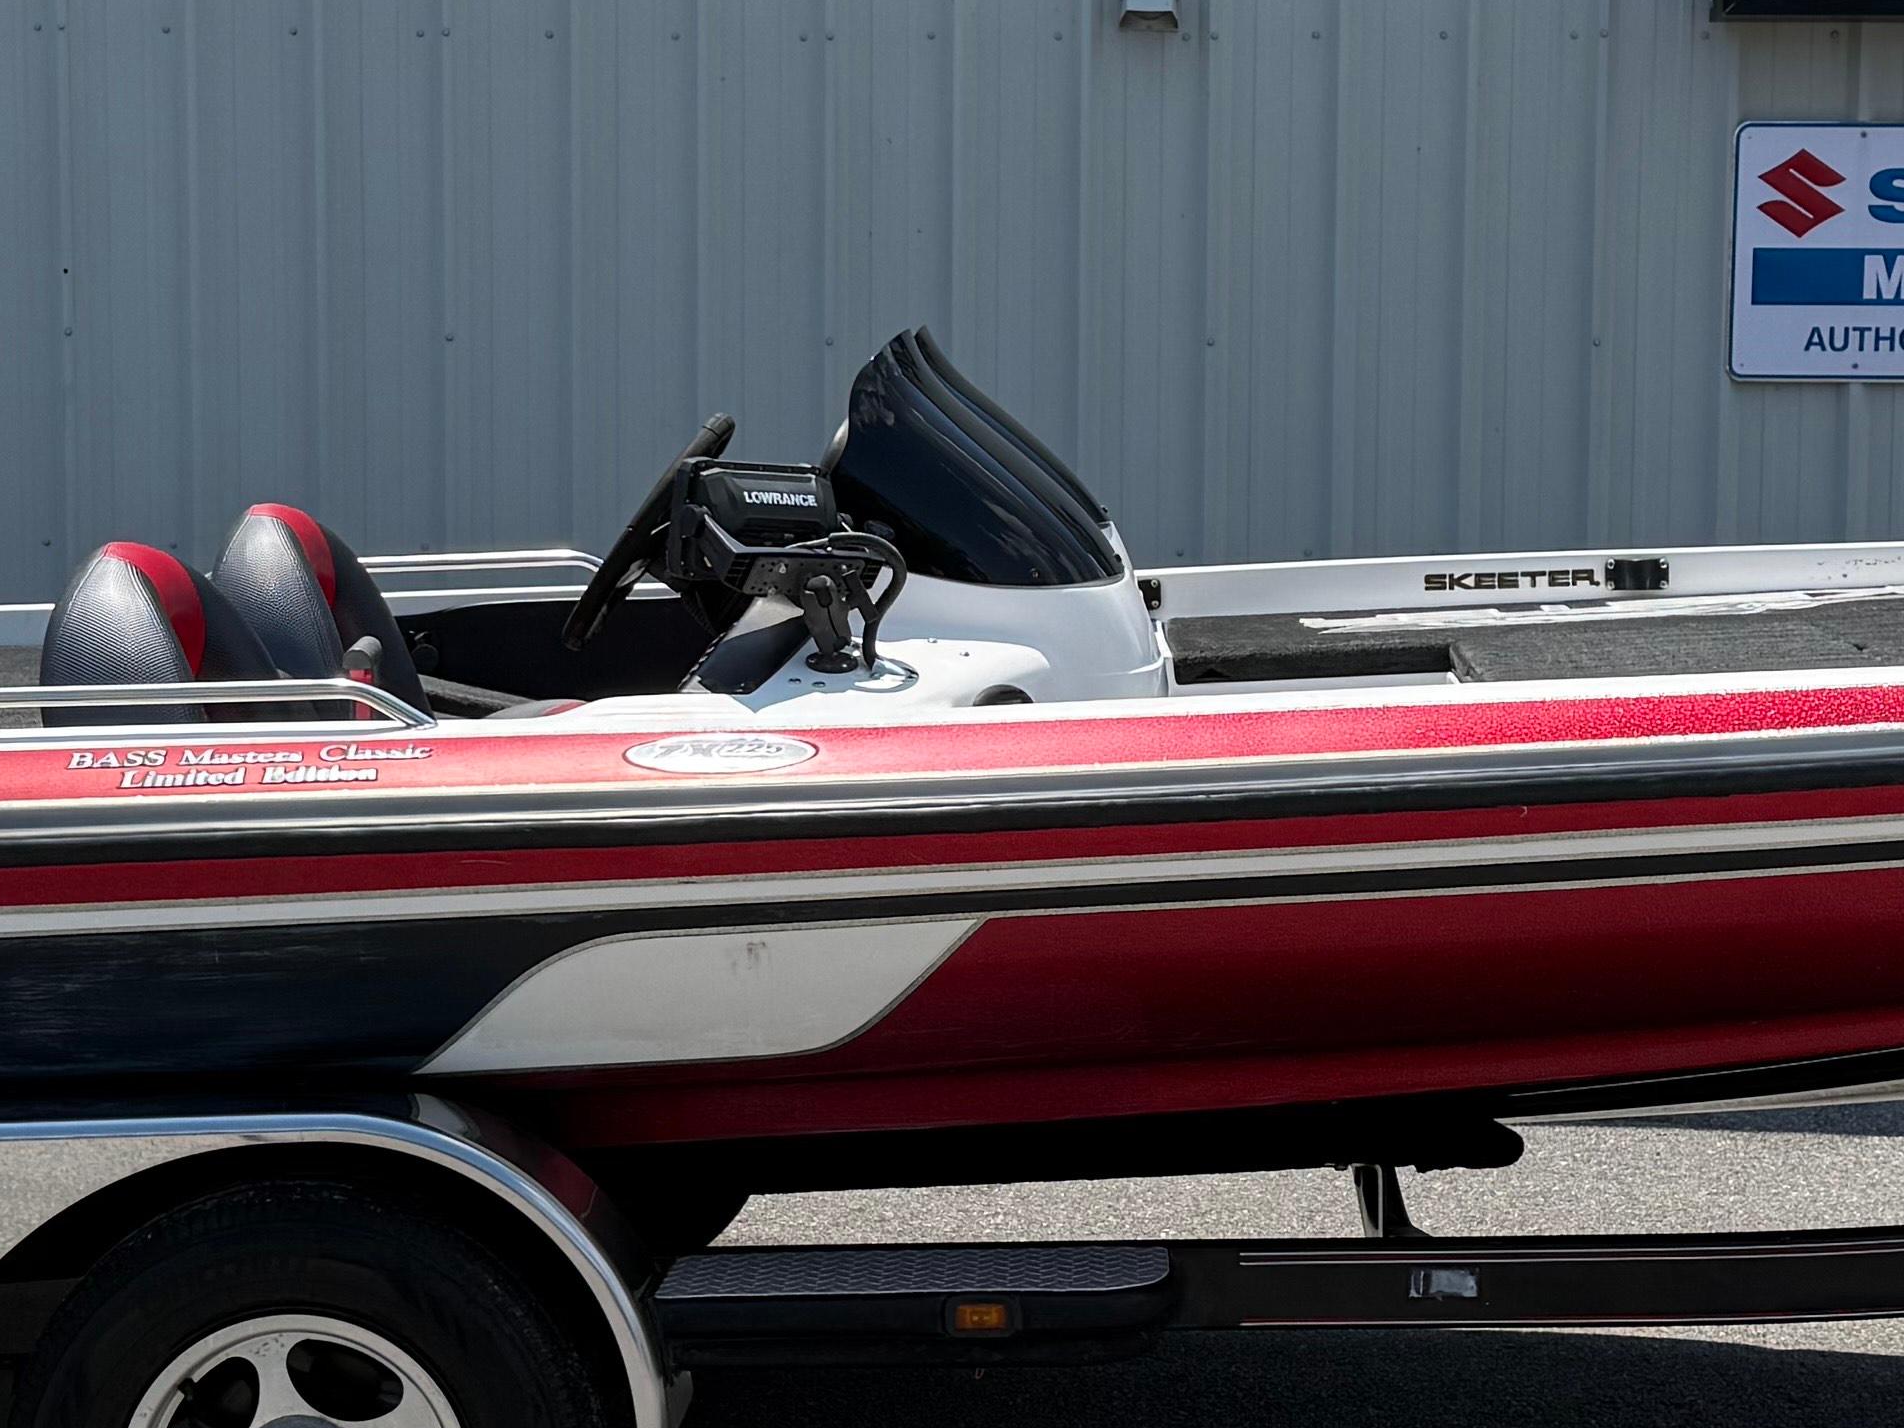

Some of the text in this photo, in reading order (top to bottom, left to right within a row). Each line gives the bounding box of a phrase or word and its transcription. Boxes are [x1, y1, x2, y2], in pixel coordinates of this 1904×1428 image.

[743, 490, 818, 507] LOWRANCE
[1423, 568, 1599, 592] SKEETER
[66, 748, 168, 770] BASS
[319, 743, 437, 762] Classic
[118, 764, 378, 790] Limited Edition
